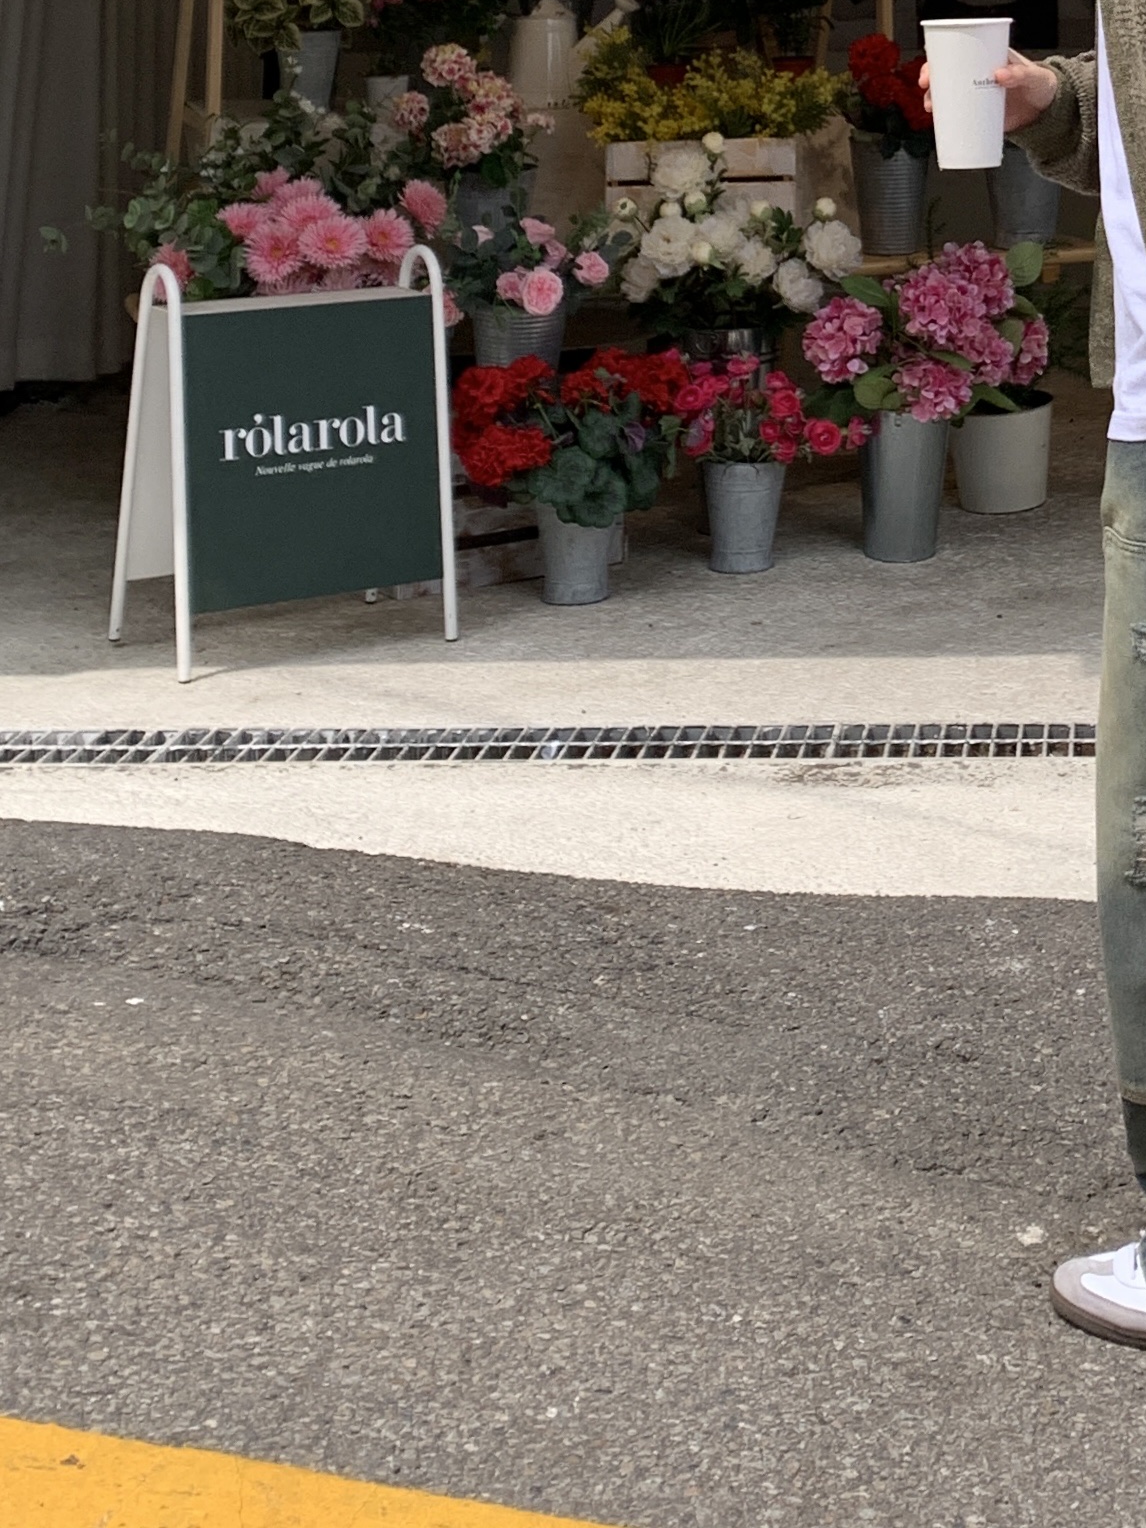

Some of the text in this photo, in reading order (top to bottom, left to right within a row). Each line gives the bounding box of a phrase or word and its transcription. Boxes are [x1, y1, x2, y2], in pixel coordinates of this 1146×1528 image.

[254, 462, 297, 476] Nouvelle
[298, 461, 325, 472] vague
[326, 457, 338, 468] de
